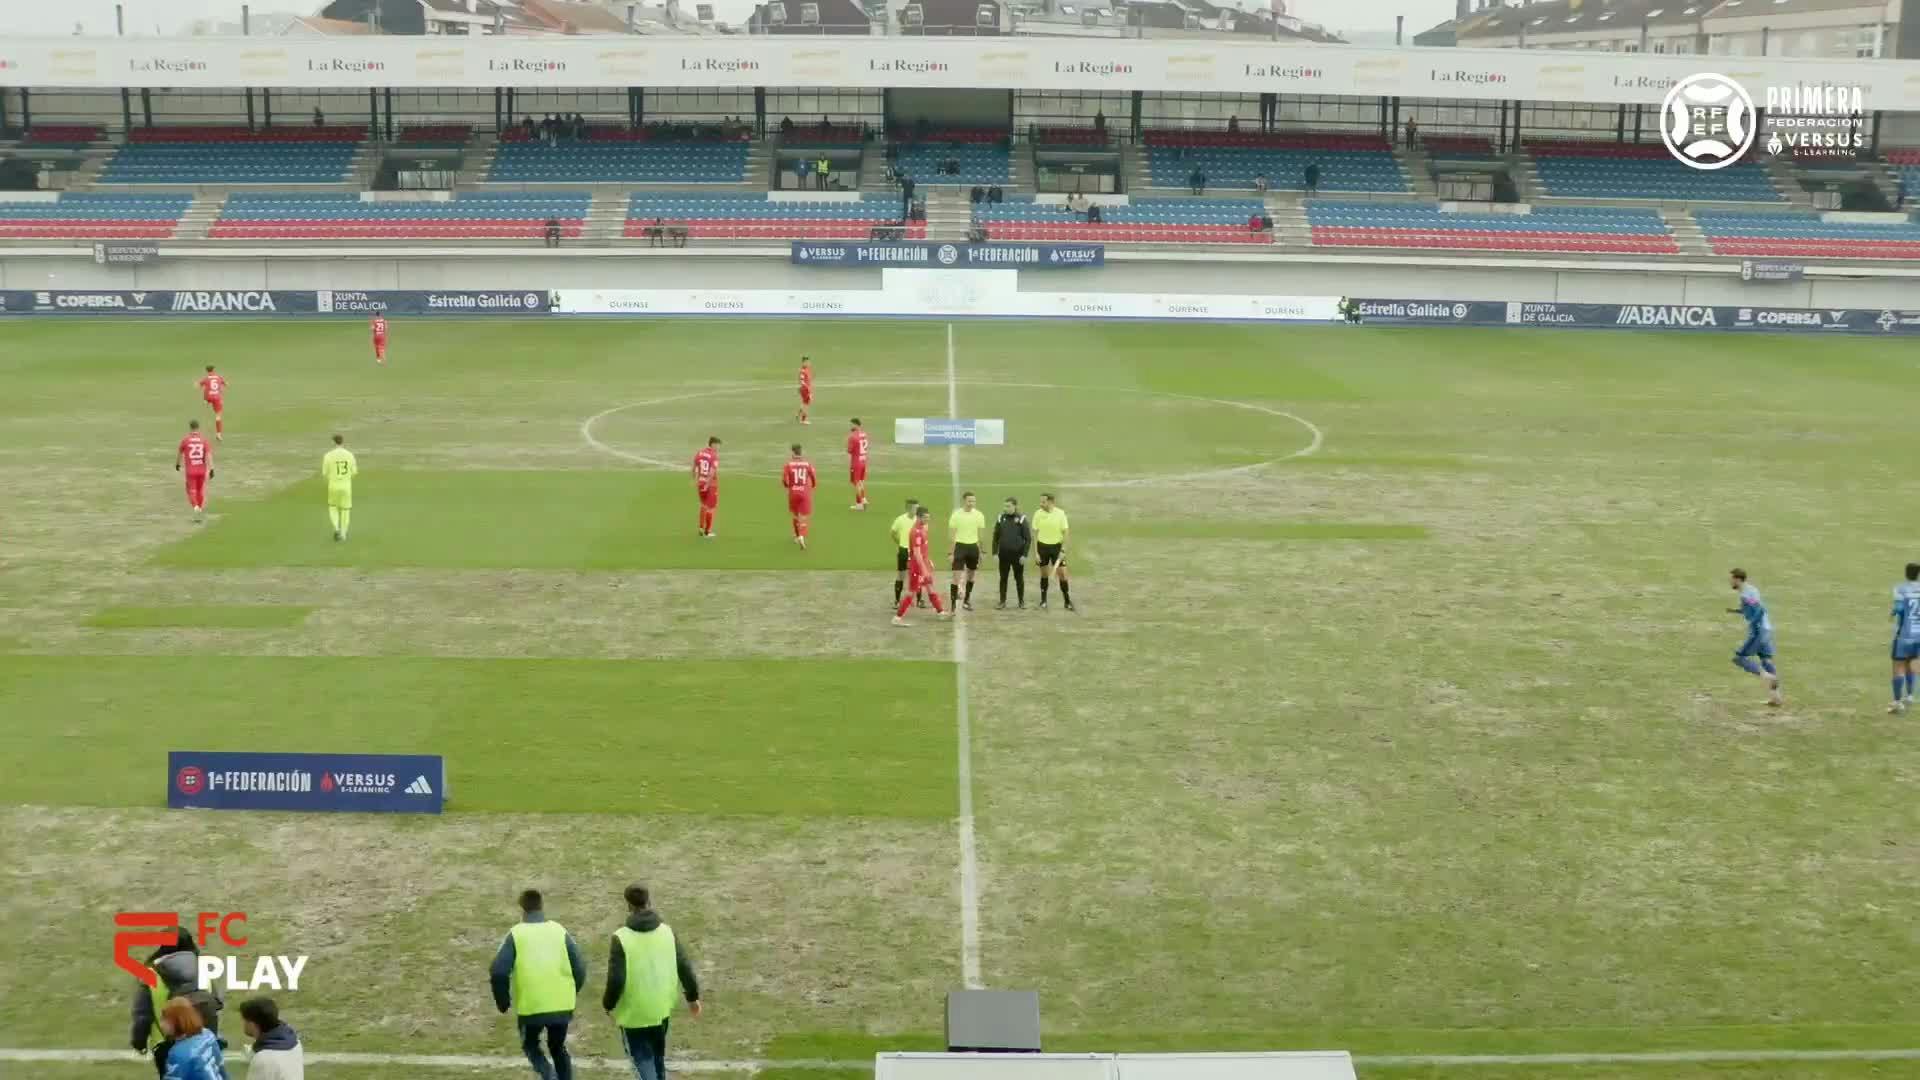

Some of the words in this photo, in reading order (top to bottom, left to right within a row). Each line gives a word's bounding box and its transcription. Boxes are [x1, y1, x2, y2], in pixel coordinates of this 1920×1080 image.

[130, 60, 150, 70] La
[308, 58, 328, 70] La
[489, 58, 509, 70] La
[682, 58, 701, 70] La
[870, 58, 890, 70] La
[1055, 60, 1075, 72] La
[1246, 64, 1265, 76] La
[1431, 69, 1451, 81] La
[808, 247, 846, 256] VERSUS
[1060, 250, 1096, 258] VERSUS
[56, 296, 125, 307] COPERSA
[335, 292, 367, 301] XUNTA
[428, 294, 475, 308] Estrella
[478, 294, 521, 308] Galicia
[350, 302, 387, 310] GALICIA
[1359, 302, 1405, 316] Estrella
[1407, 303, 1450, 317] Galicia
[1524, 304, 1556, 312] XUNTA
[1523, 314, 1535, 322] DE
[1537, 314, 1575, 323] GALICIA
[1757, 312, 1822, 325] COPERSA
[210, 379, 218, 390] 6
[336, 460, 348, 475] 13
[792, 468, 806, 484] 14
[225, 770, 312, 792] FEDERACIÓN
[334, 773, 396, 786] VERSUS
